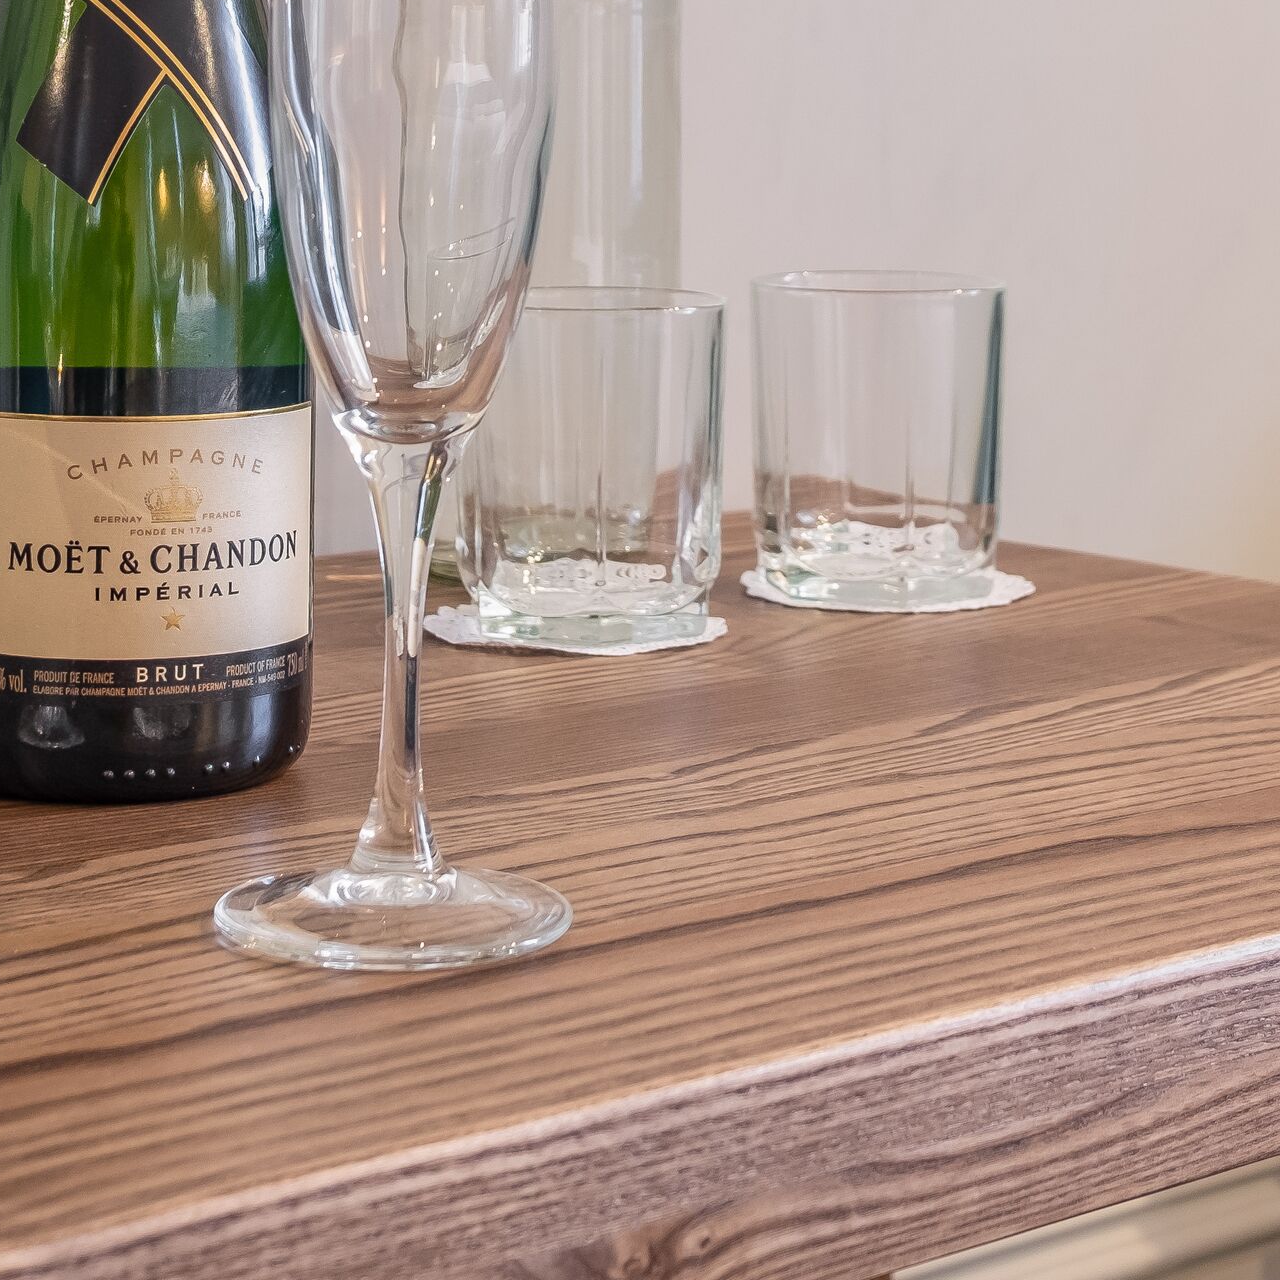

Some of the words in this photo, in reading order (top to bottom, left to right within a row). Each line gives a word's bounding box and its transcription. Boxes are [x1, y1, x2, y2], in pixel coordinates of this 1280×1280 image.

[67, 448, 264, 480] CHAMPAGNE
[94, 515, 143, 524] ÉPERNAY
[202, 510, 242, 521] FRANCE
[130, 528, 166, 537] FONDÉ
[171, 528, 185, 536] EN
[190, 526, 213, 535] 1743
[7, 540, 111, 574] MOËT
[119, 550, 142, 574] &
[150, 529, 298, 573] CHANDON
[95, 581, 240, 601] IMPÉRIAL
[136, 663, 205, 683] BRUT
[226, 661, 257, 677] PRODUCT
[256, 660, 266, 673] OF
[265, 655, 286, 671] FRANCE
[9, 668, 27, 693] vol.
[33, 670, 68, 684] PRODUIT
[69, 671, 81, 684] DE
[82, 672, 115, 685] FRANCE
[65, 686, 80, 696] PAR
[81, 686, 126, 697] CHAMPAGNE
[148, 686, 155, 696] &
[155, 683, 190, 696] CHANDON
[231, 677, 254, 689] FRANCE
